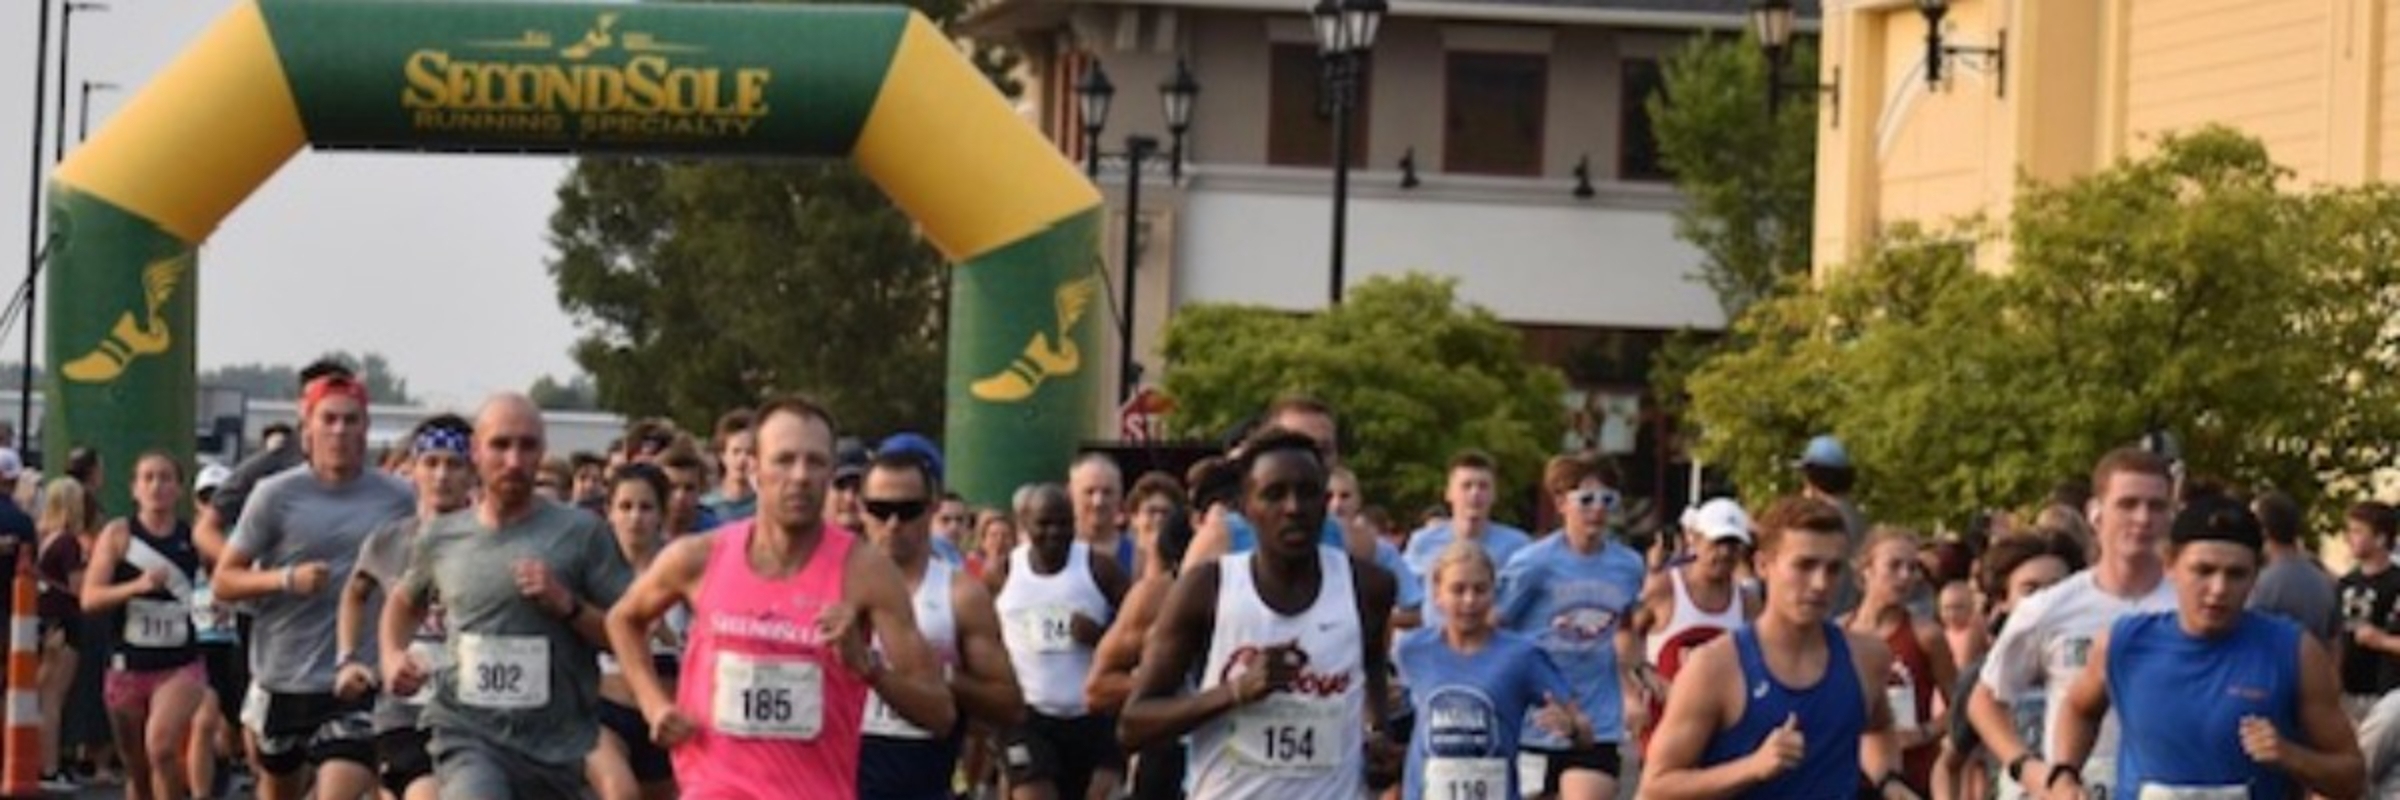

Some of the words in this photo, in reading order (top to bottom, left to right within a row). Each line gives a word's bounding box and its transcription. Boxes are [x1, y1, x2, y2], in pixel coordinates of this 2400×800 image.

[414, 112, 563, 132] RUNNING
[580, 115, 755, 135] SPECIALTY
[476, 662, 522, 694] 302
[741, 688, 791, 721] 185
[1264, 726, 1314, 761] 154
